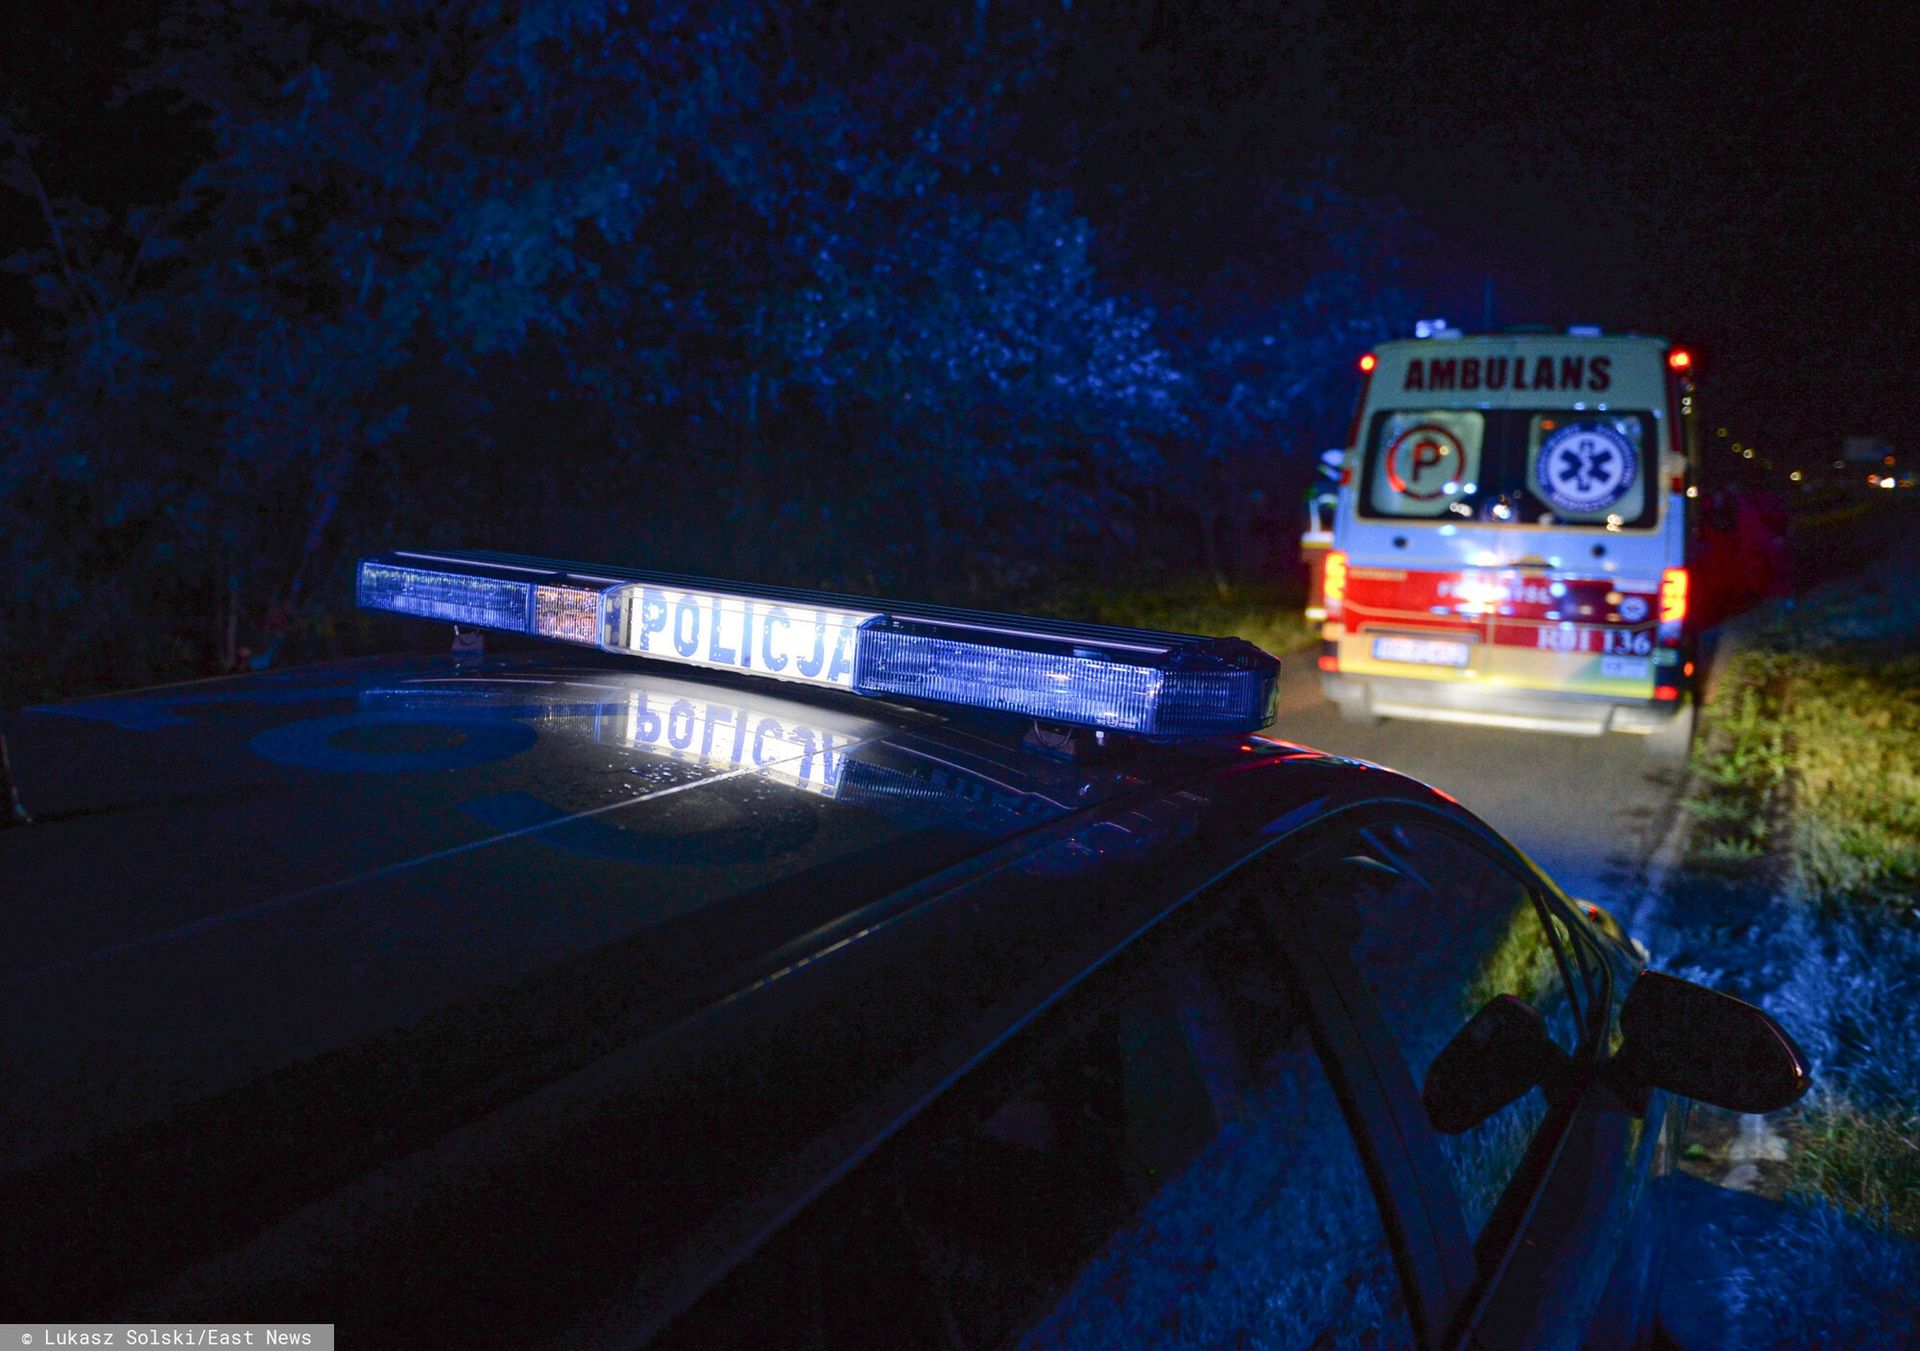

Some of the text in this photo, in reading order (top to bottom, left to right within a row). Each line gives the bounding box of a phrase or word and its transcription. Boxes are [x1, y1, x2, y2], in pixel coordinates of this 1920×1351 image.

[1403, 356, 1612, 392] AMBULANS
[1412, 438, 1443, 482] P
[1603, 629, 1652, 656] 136
